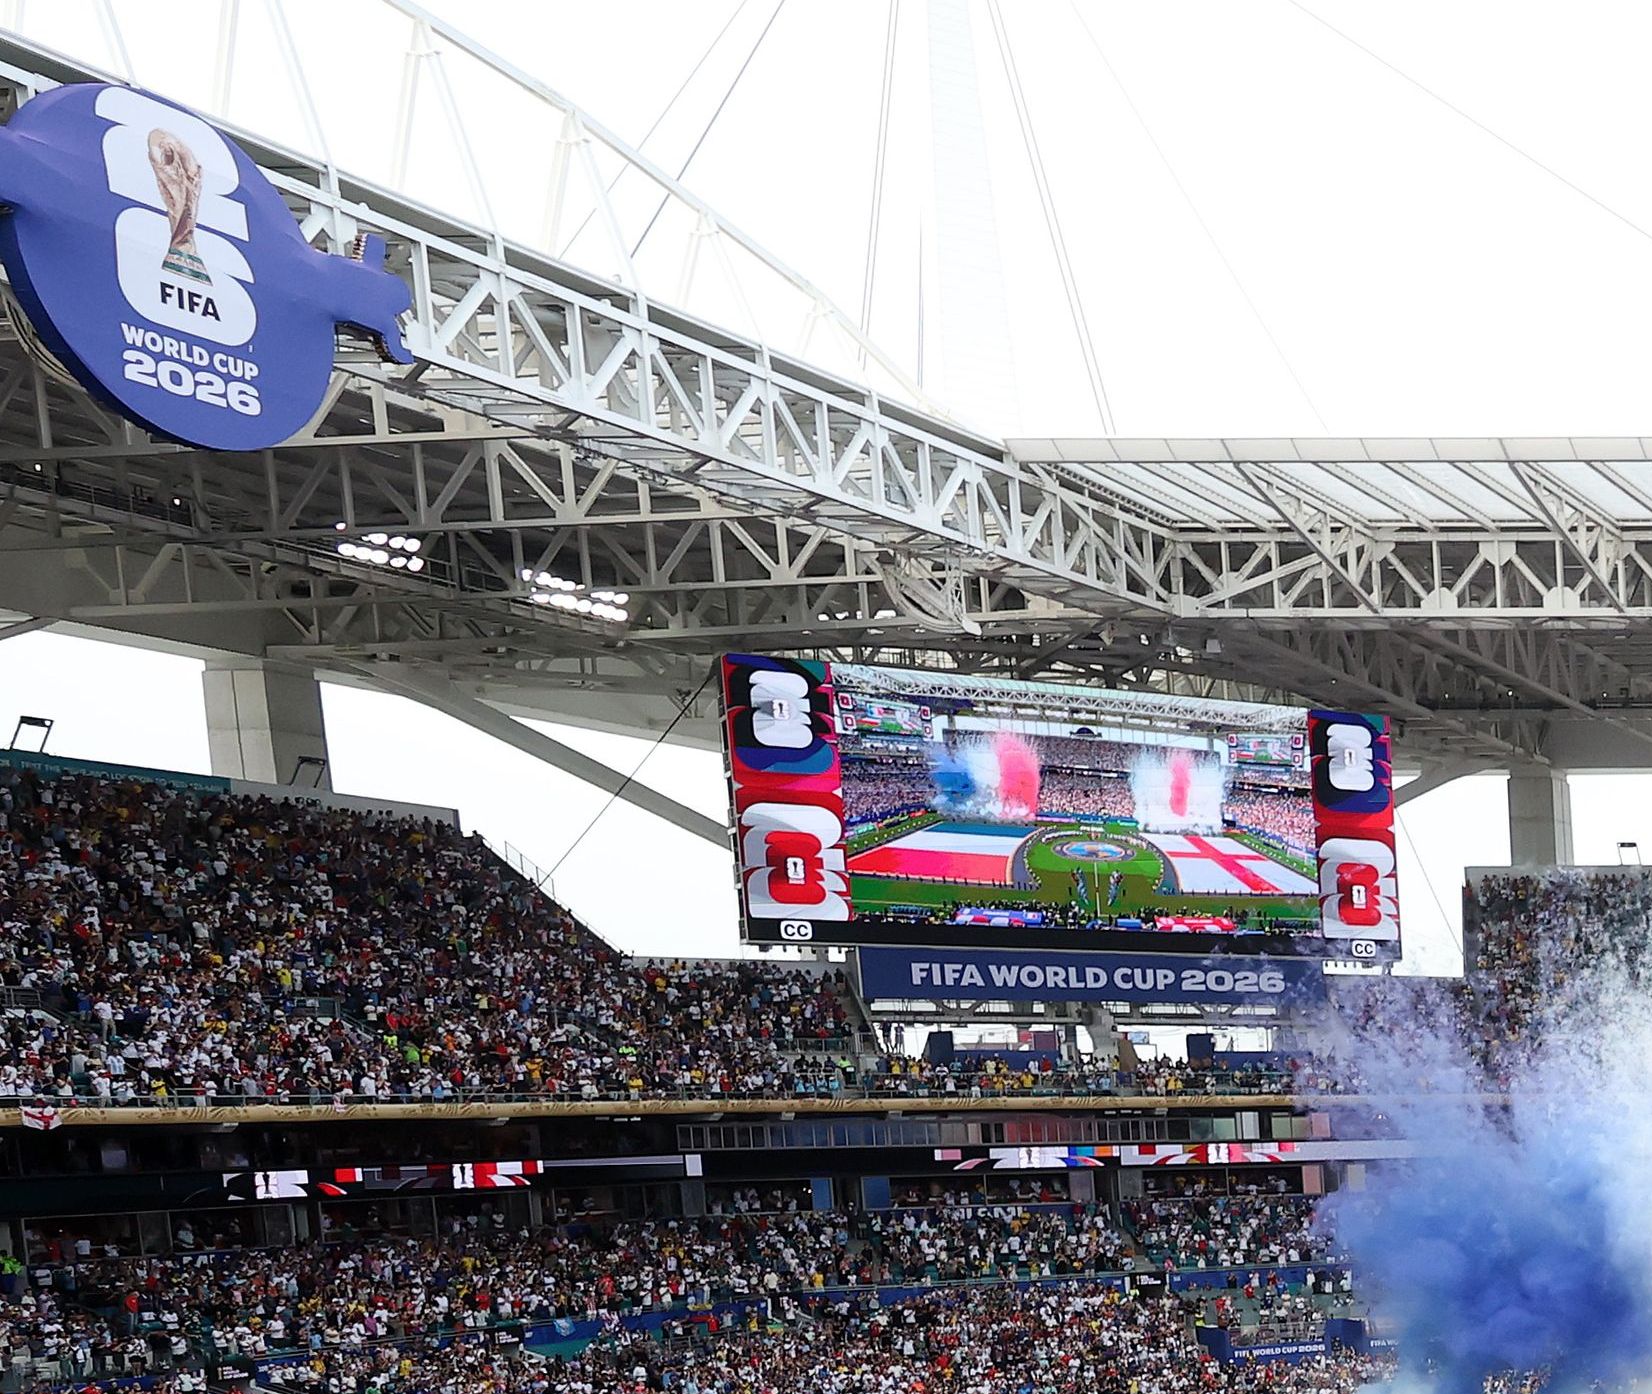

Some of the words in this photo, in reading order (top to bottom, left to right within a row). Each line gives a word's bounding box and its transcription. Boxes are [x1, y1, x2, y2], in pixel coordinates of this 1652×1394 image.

[159, 281, 221, 322] FIFA
[120, 322, 210, 367] WORLD
[213, 355, 259, 380] CUP
[122, 350, 261, 416] 2026
[783, 922, 809, 938] CC
[1354, 942, 1373, 955] CC
[910, 960, 985, 987] FIFA
[993, 964, 1105, 990] WORLD
[1113, 967, 1175, 991] CUP
[1181, 969, 1285, 993] 2026
[1252, 1347, 1281, 1357] WORLD
[1282, 1346, 1298, 1355] CUP
[1298, 1344, 1326, 1353] 2026
